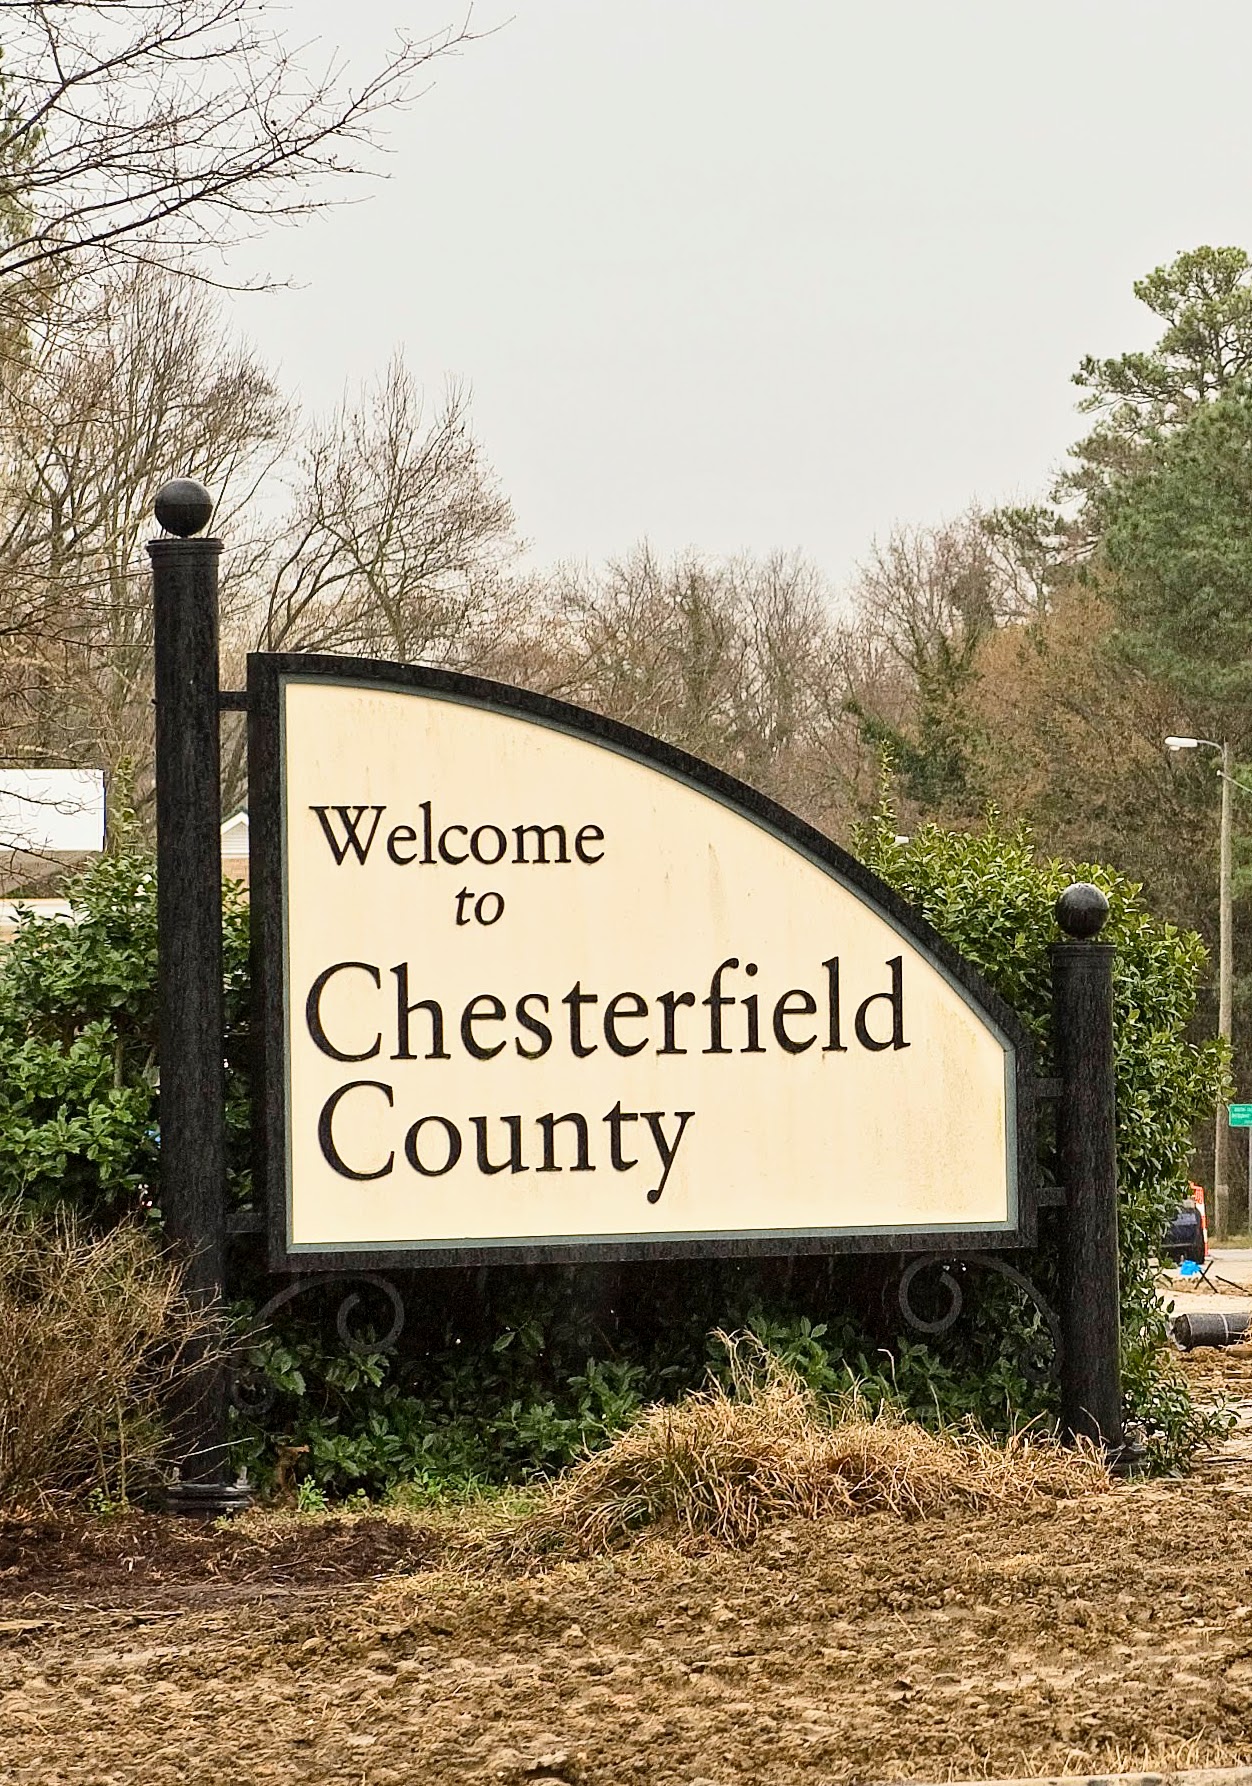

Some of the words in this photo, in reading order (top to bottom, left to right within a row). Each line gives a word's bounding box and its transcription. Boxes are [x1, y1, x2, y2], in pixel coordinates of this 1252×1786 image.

[309, 800, 605, 866] Welcome
[454, 885, 505, 926] to
[305, 955, 911, 1063] Chesterfield
[317, 1080, 695, 1204] County
